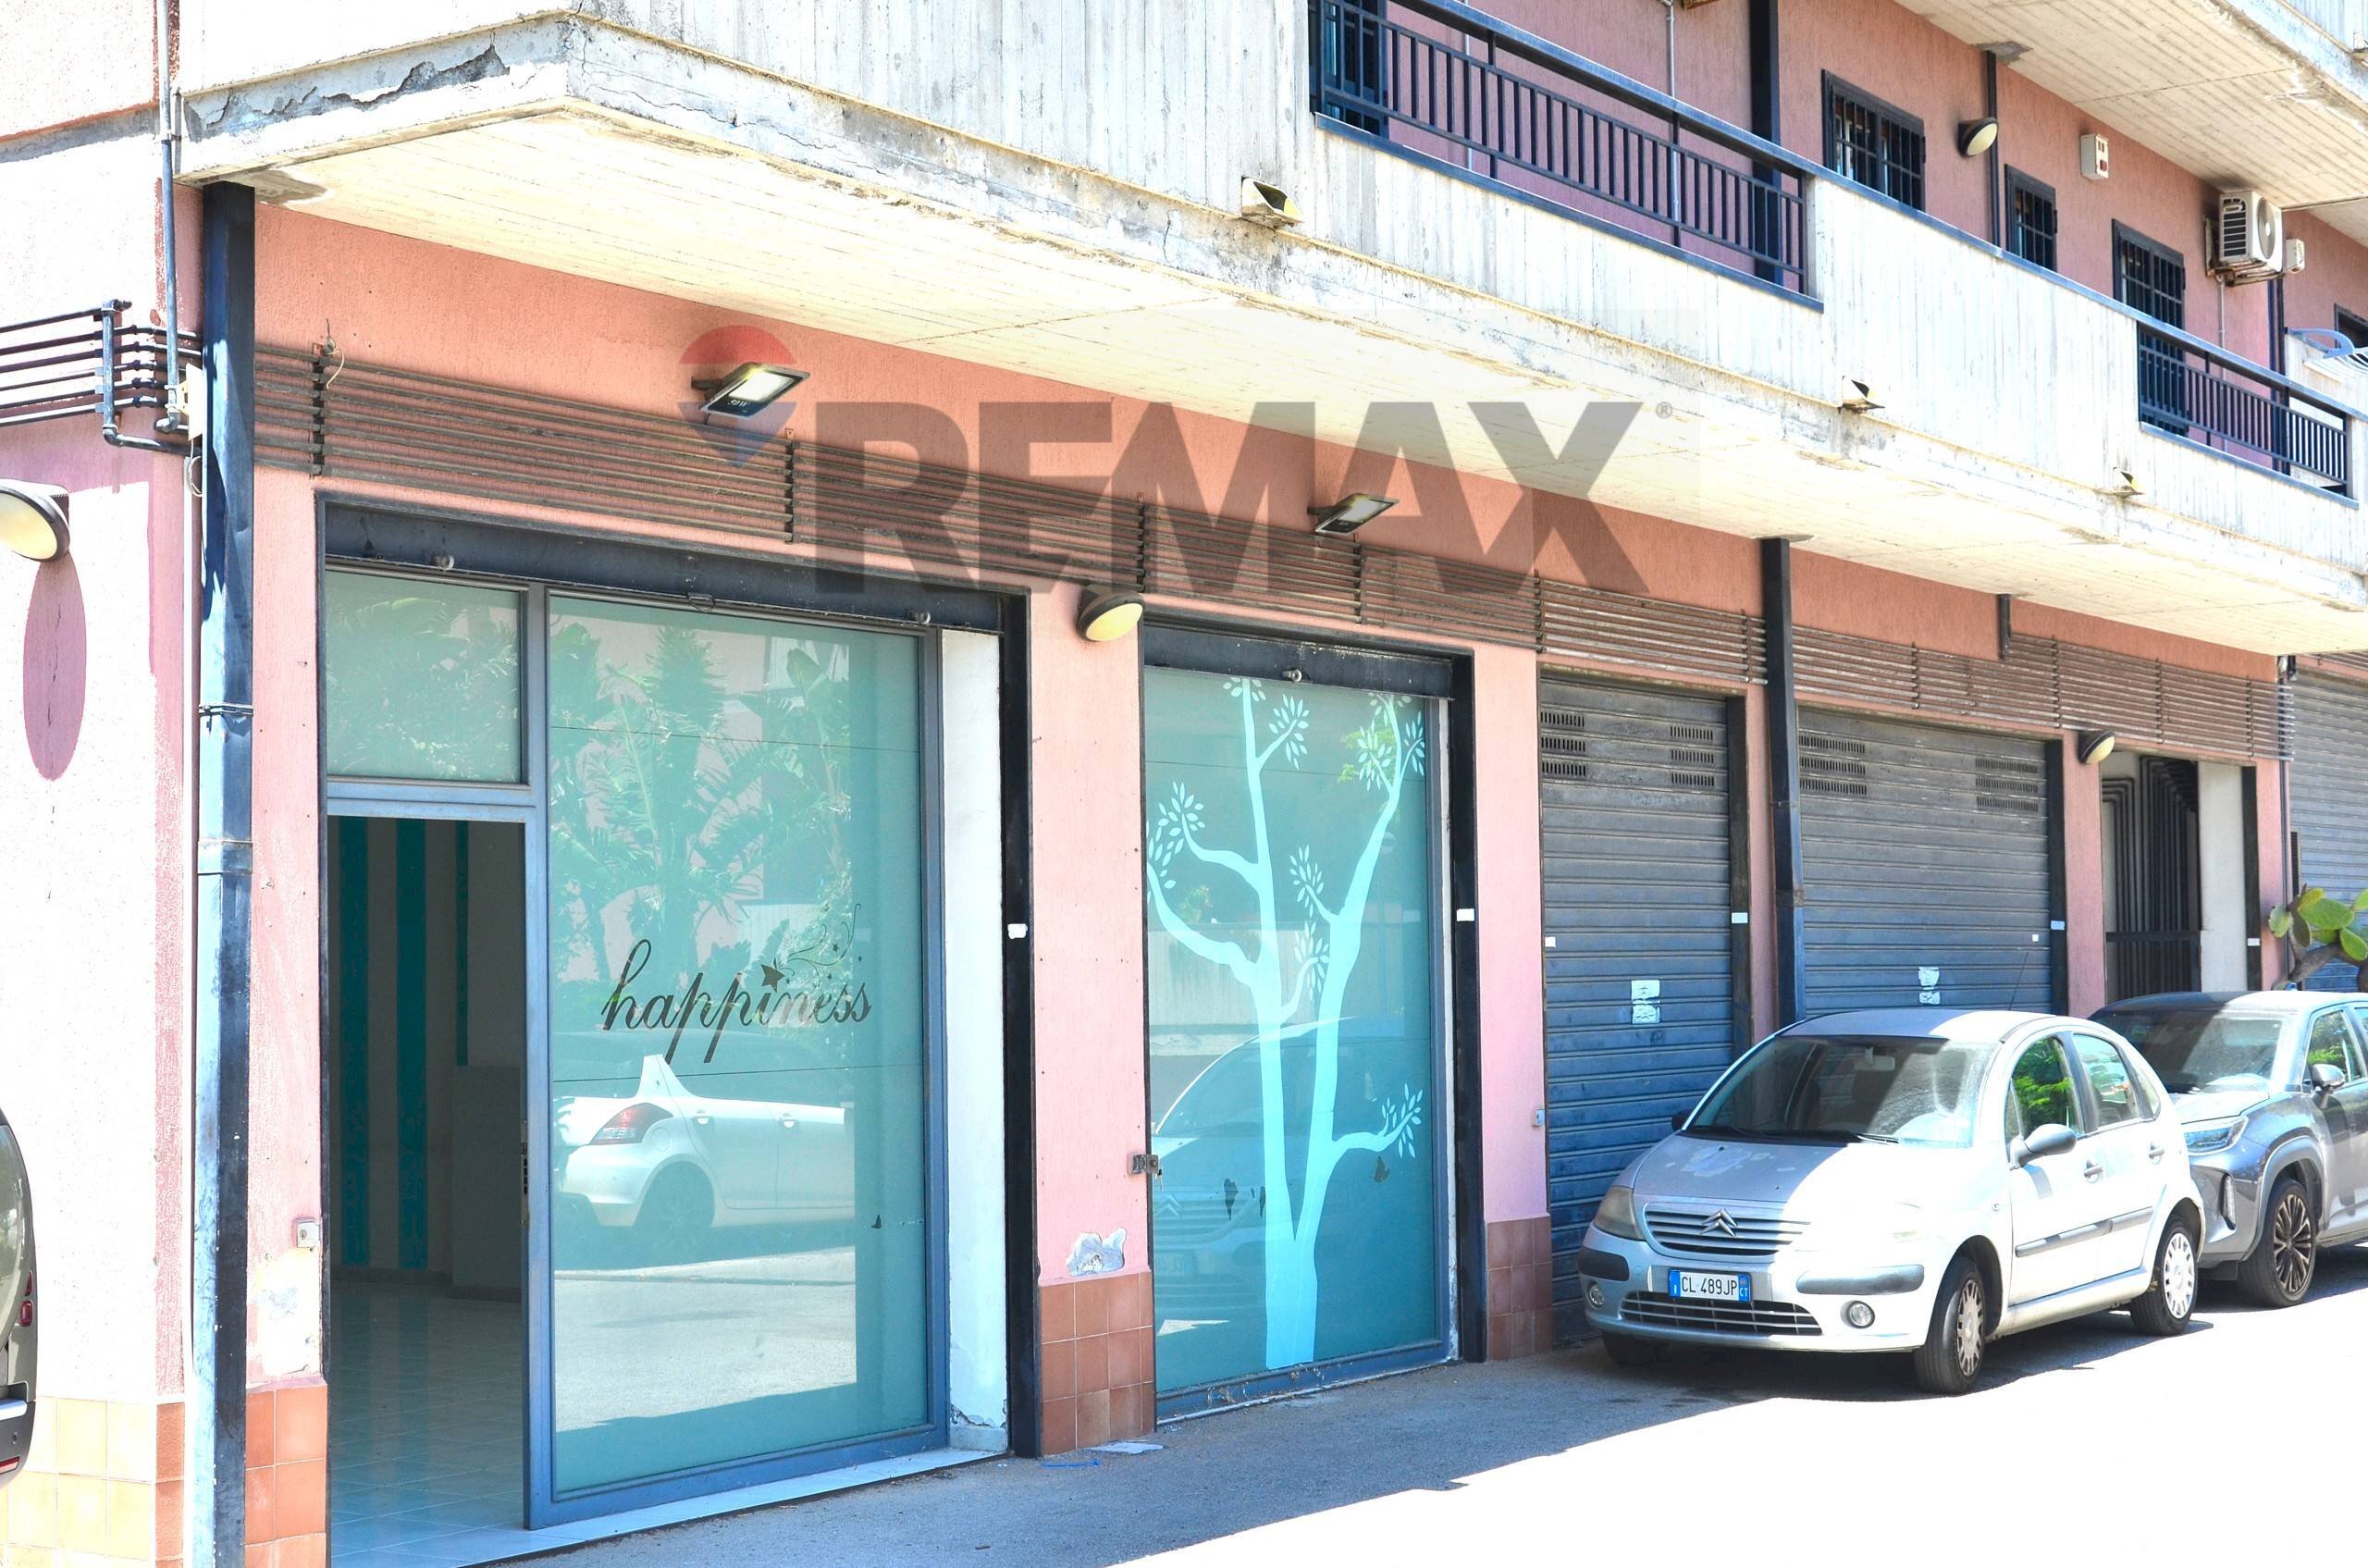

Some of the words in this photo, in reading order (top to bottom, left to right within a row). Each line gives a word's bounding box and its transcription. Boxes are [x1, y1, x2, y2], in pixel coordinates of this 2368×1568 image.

[601, 939, 871, 1065] happiness
[1681, 1277, 1696, 1293] CL
[1700, 1278, 1738, 1296] 489JP
